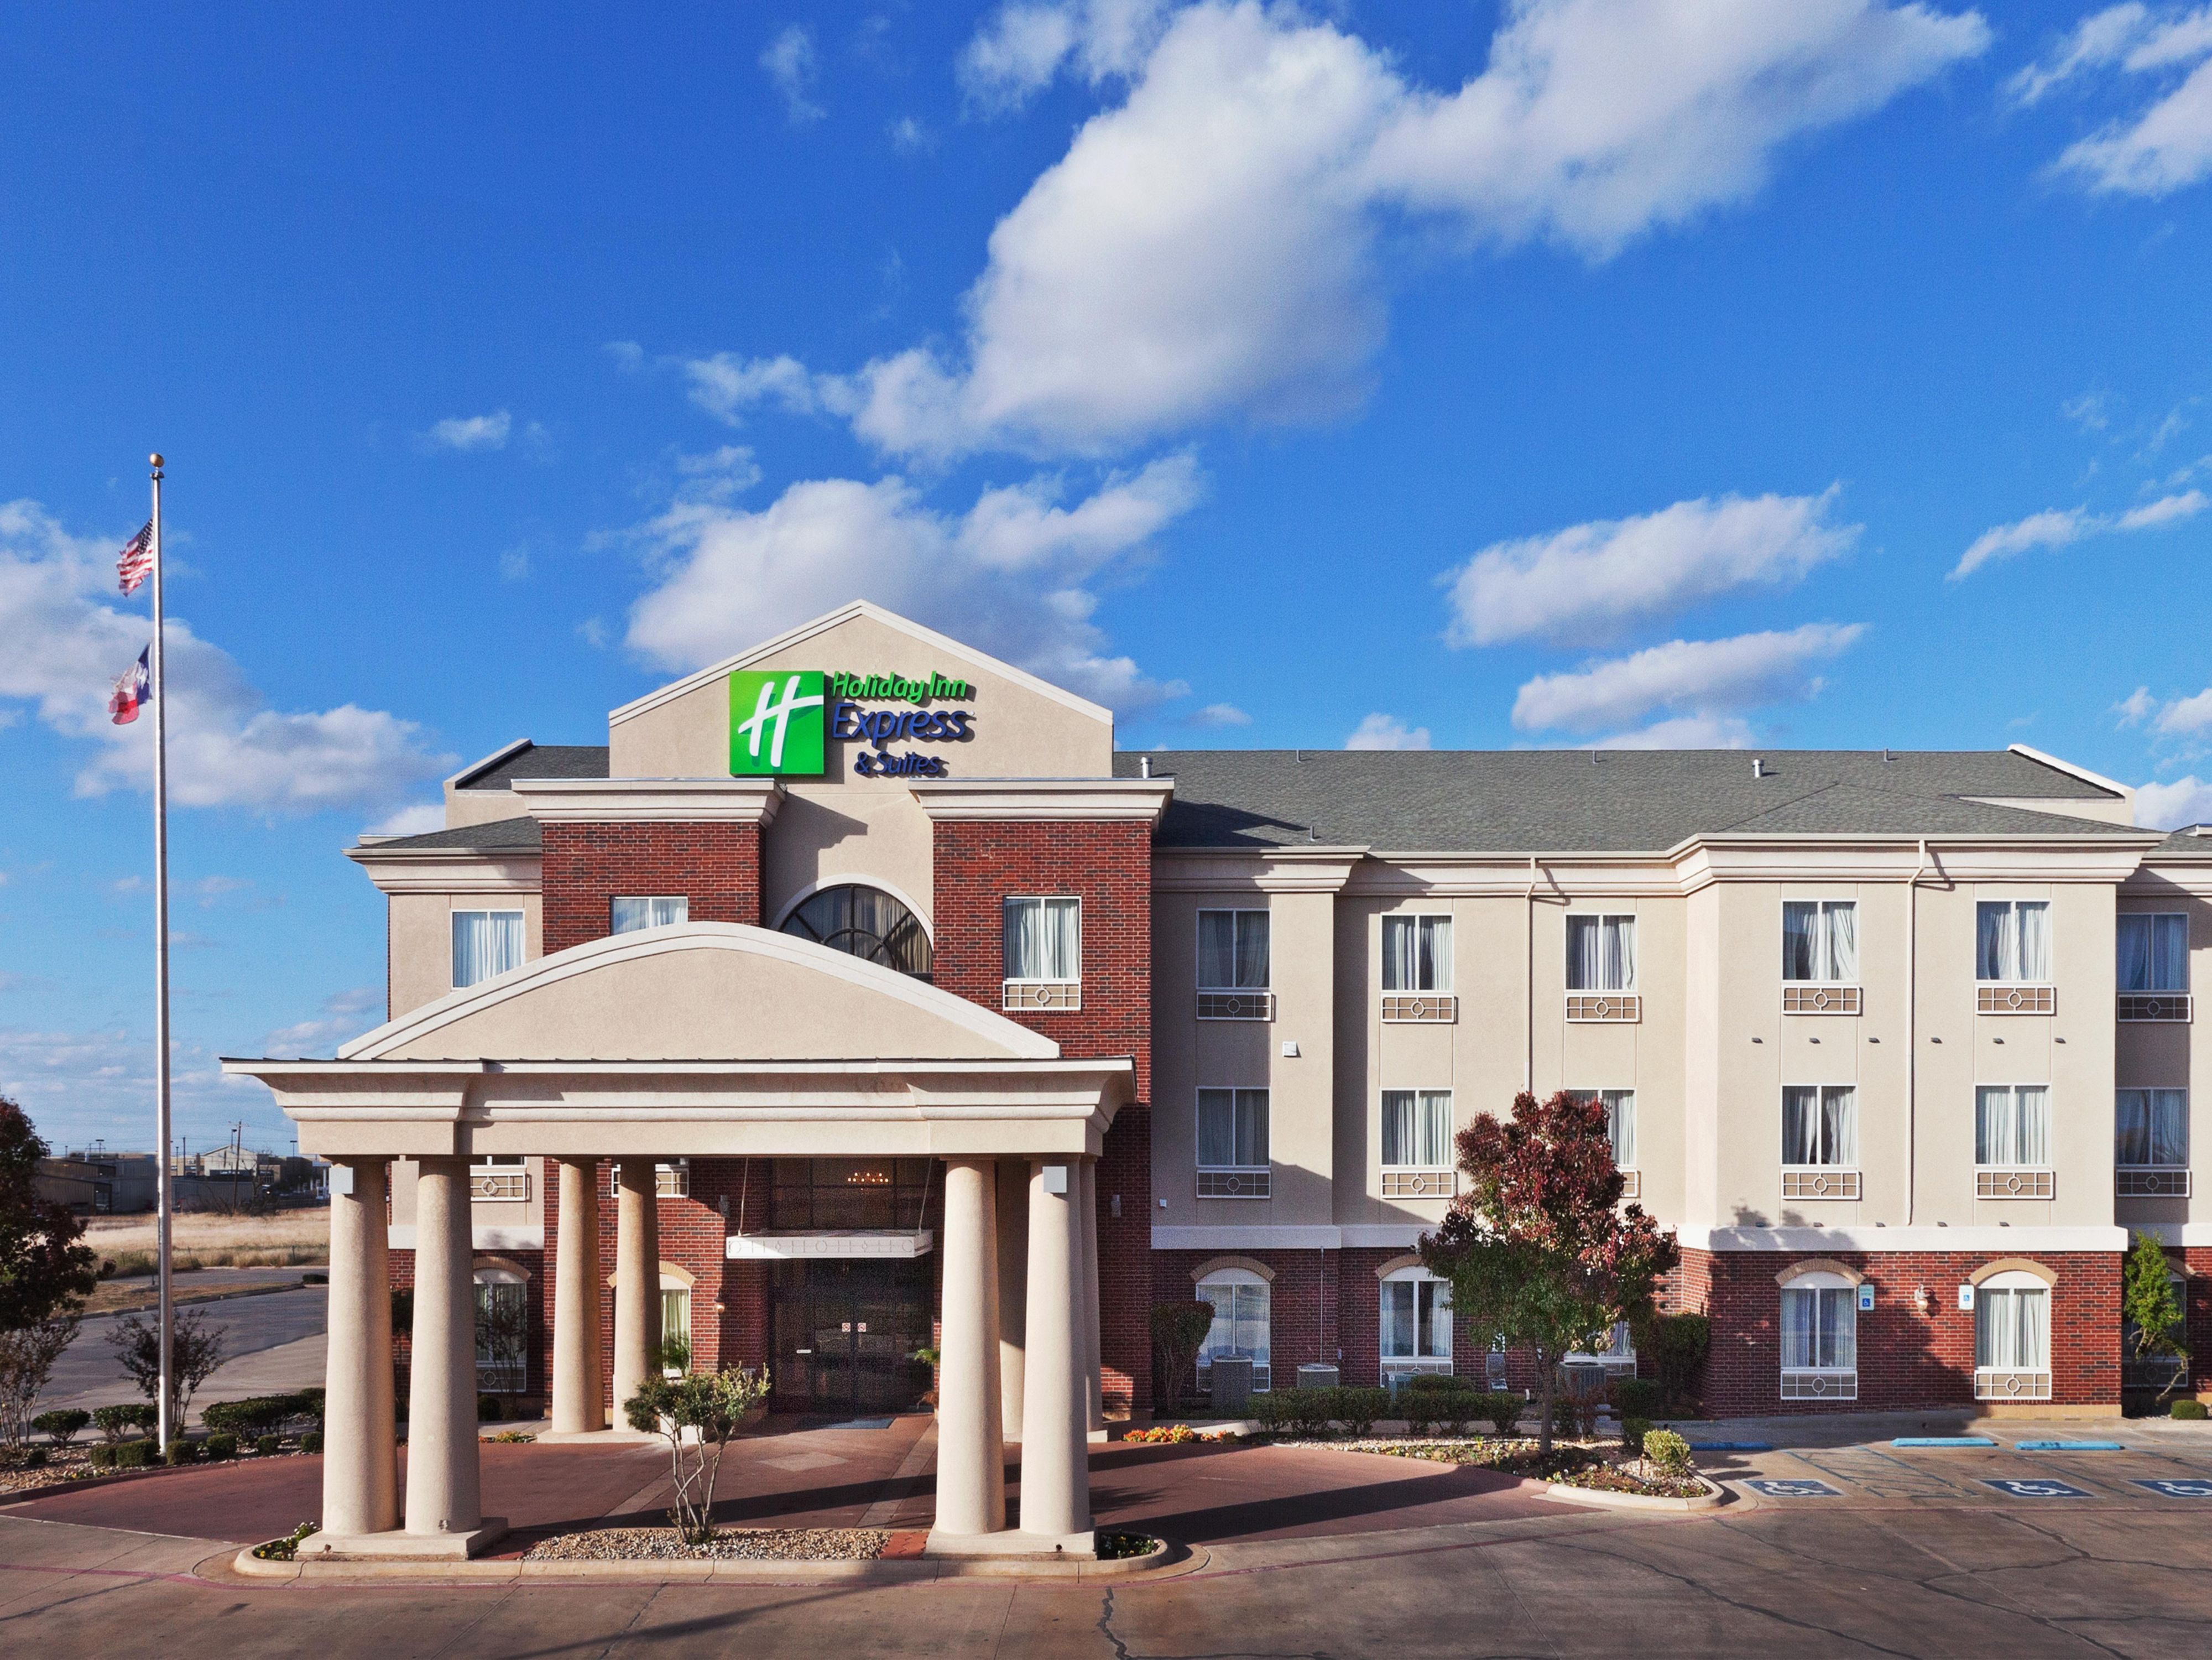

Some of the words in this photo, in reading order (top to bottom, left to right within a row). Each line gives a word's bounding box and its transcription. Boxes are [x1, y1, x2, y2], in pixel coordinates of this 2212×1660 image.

[832, 670, 925, 704] Holiday
[928, 670, 967, 698] Inn
[832, 702, 967, 748] Express
[853, 751, 870, 774] &
[873, 750, 940, 774] Suites
